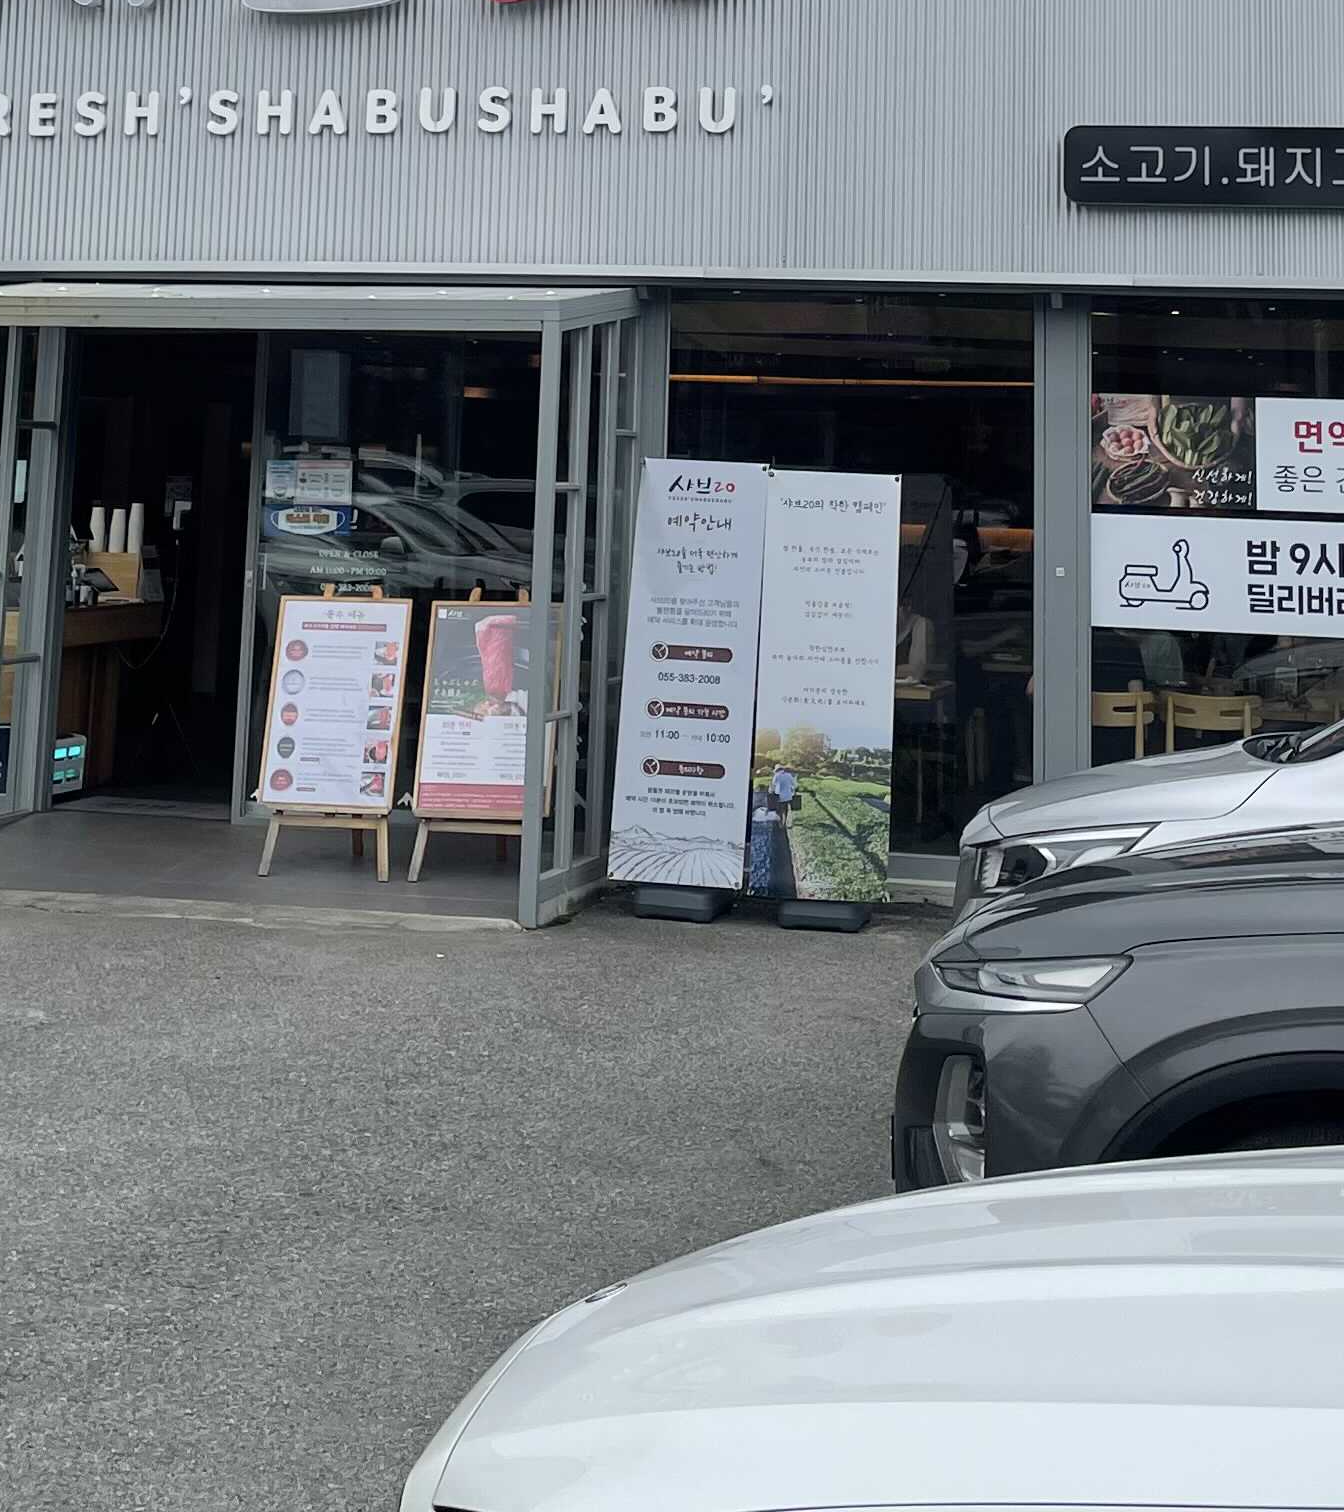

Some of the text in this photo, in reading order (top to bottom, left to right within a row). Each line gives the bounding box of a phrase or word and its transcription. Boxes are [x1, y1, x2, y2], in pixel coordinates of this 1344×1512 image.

[1273, 465, 1326, 494] 좋은
[668, 512, 732, 533] 예약안내
[1246, 540, 1280, 576] 밤
[657, 672, 721, 685] 055-383-2008
[655, 730, 680, 740] 11:00
[706, 733, 731, 744] 10:00
